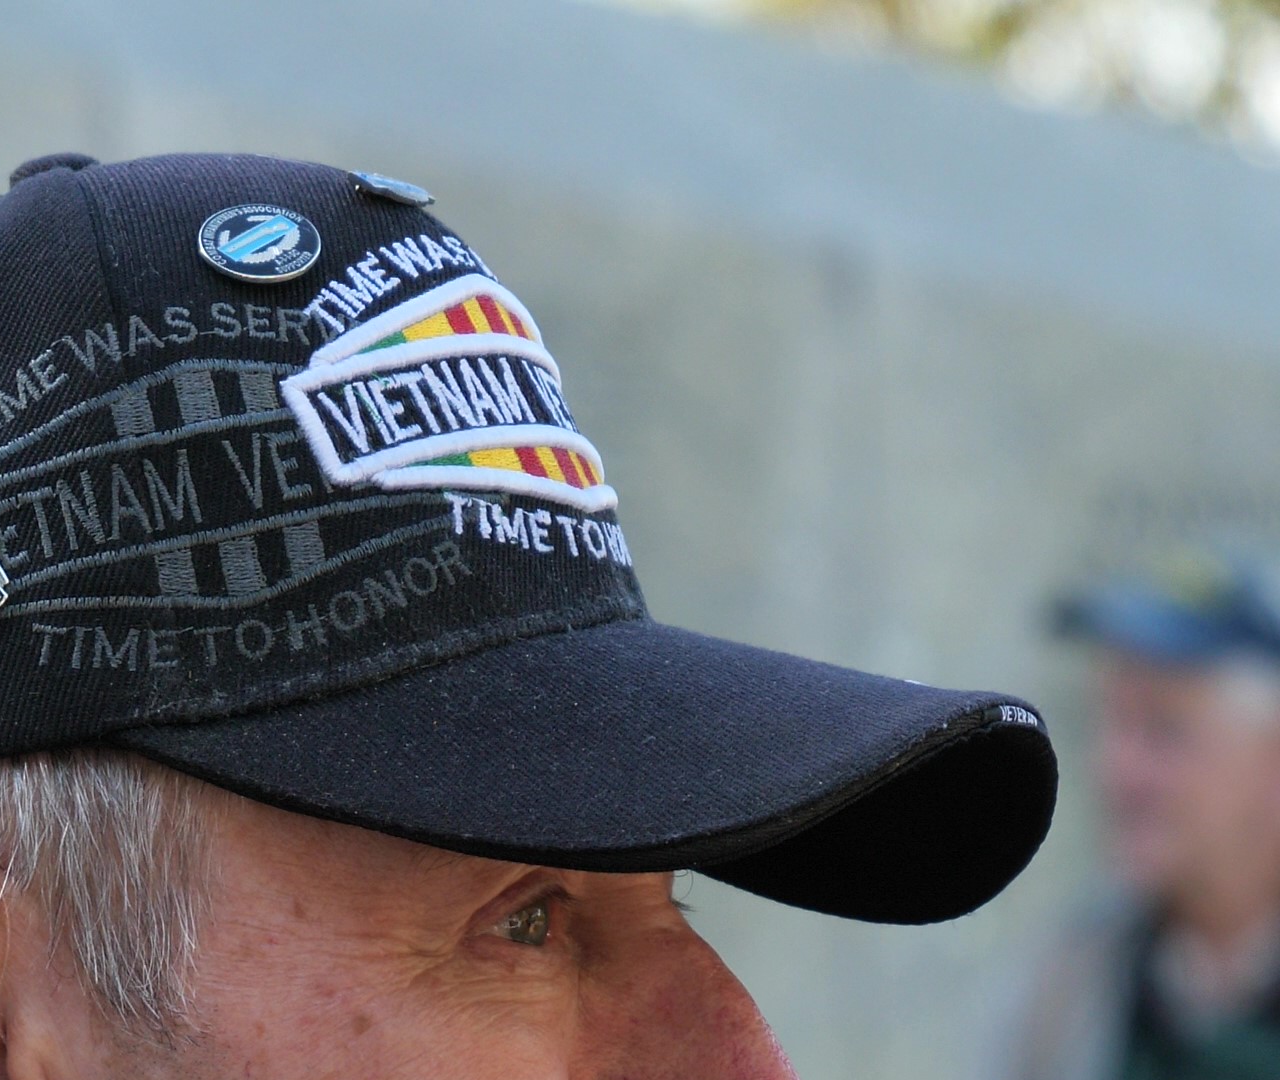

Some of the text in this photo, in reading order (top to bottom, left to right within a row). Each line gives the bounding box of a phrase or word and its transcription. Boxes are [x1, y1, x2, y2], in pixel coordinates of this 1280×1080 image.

[303, 252, 401, 332] TIME
[380, 234, 477, 277] WAS
[71, 305, 198, 372] WAS
[317, 356, 536, 453] VIETNAM
[444, 491, 554, 554] TIME
[554, 514, 608, 560] TO
[32, 540, 473, 672] TIME TO HONOR
[1000, 705, 1038, 727] VETERAN
